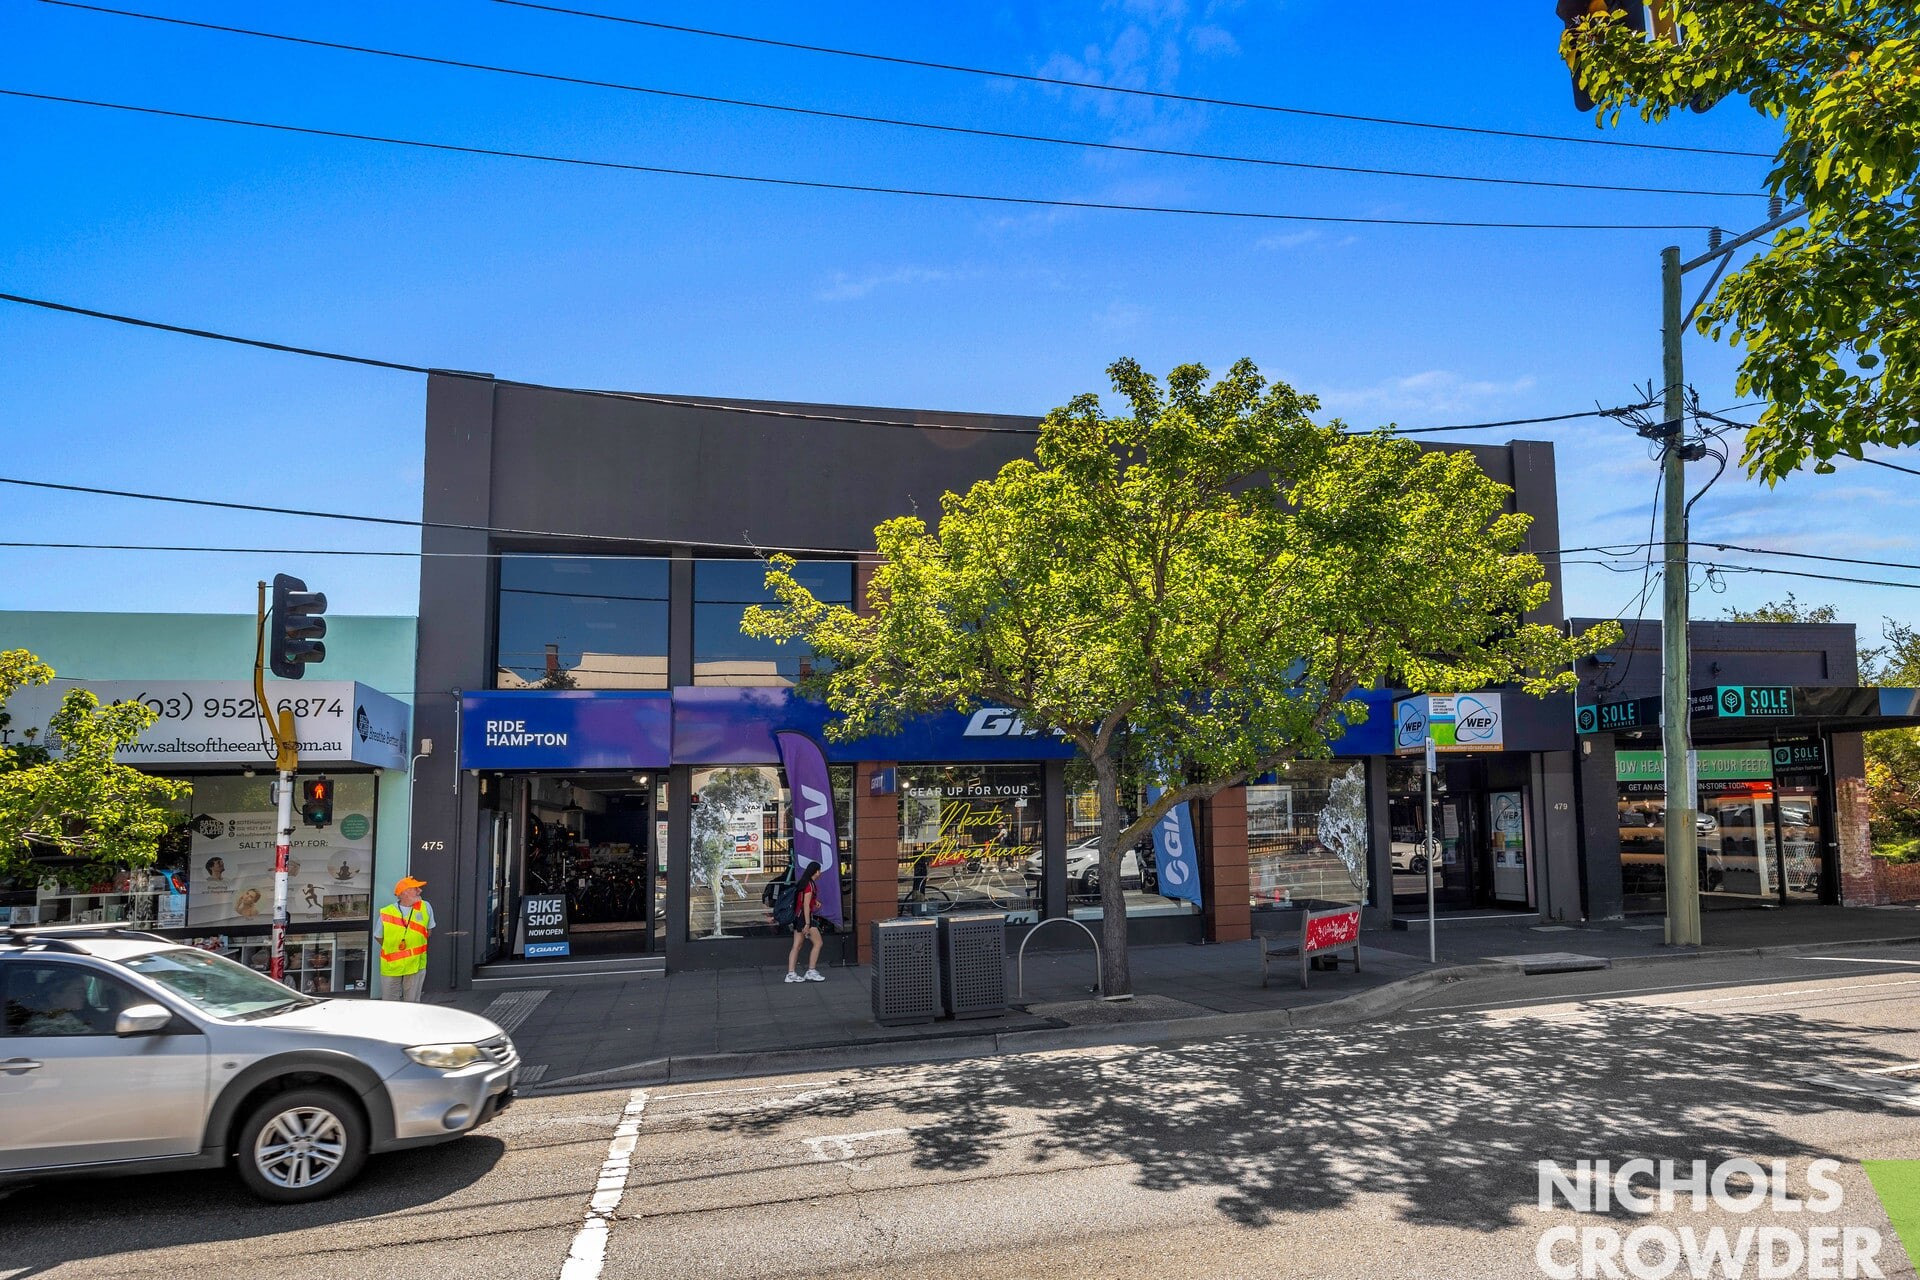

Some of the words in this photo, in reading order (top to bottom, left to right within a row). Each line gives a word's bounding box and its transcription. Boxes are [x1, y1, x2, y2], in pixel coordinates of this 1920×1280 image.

[1750, 689, 1788, 708] SOLE
[1602, 703, 1635, 723] SOLE
[486, 720, 526, 732] RIDE
[1405, 721, 1422, 732] WEP
[1466, 718, 1492, 728] WEP
[115, 738, 342, 753] www.saltsoftheearthom.au
[486, 733, 567, 746] HAMPTON
[1794, 747, 1819, 758] SOLE
[1641, 760, 1664, 774] HEAL
[1711, 759, 1737, 772] YOUR
[1740, 759, 1768, 772] FEET?
[909, 787, 943, 797] GEAR
[947, 787, 963, 796] UP
[967, 786, 991, 795] FOR
[995, 785, 1028, 795] YOUR
[1698, 782, 1727, 790] IN-STORE
[937, 800, 1005, 836] Next
[264, 841, 305, 849] THAPY
[421, 841, 444, 851] 475
[904, 837, 1033, 875] Adventure
[527, 900, 562, 914] BIKE
[528, 914, 563, 926] SHOP
[545, 928, 564, 936] OPEN
